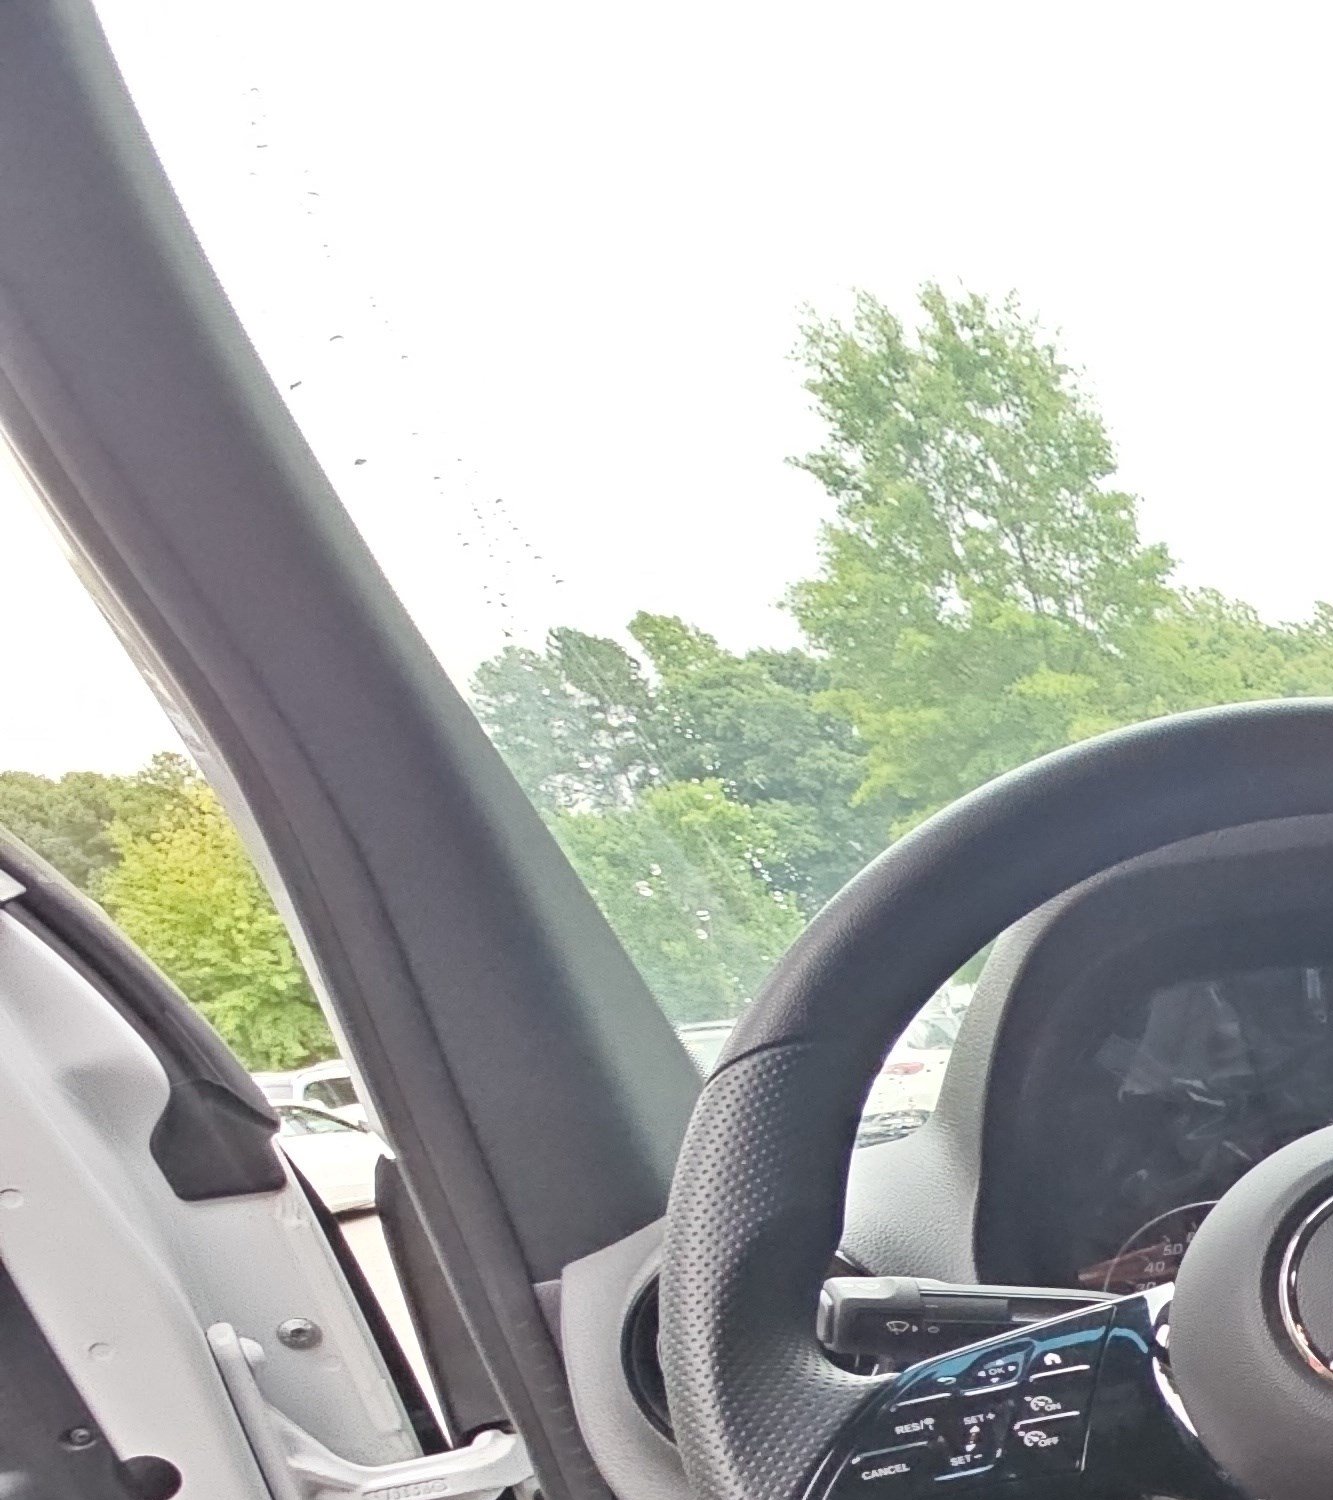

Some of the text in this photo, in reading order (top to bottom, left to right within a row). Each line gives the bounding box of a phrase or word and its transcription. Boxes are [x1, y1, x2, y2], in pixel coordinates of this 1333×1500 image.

[1144, 1261, 1165, 1273] 40
[988, 1366, 1006, 1377] OK
[1045, 1402, 1062, 1412] ON
[963, 1412, 985, 1426] SET
[1038, 1436, 1060, 1447] OFF
[949, 1454, 972, 1466] SET
[861, 1462, 911, 1480] CANCEL
